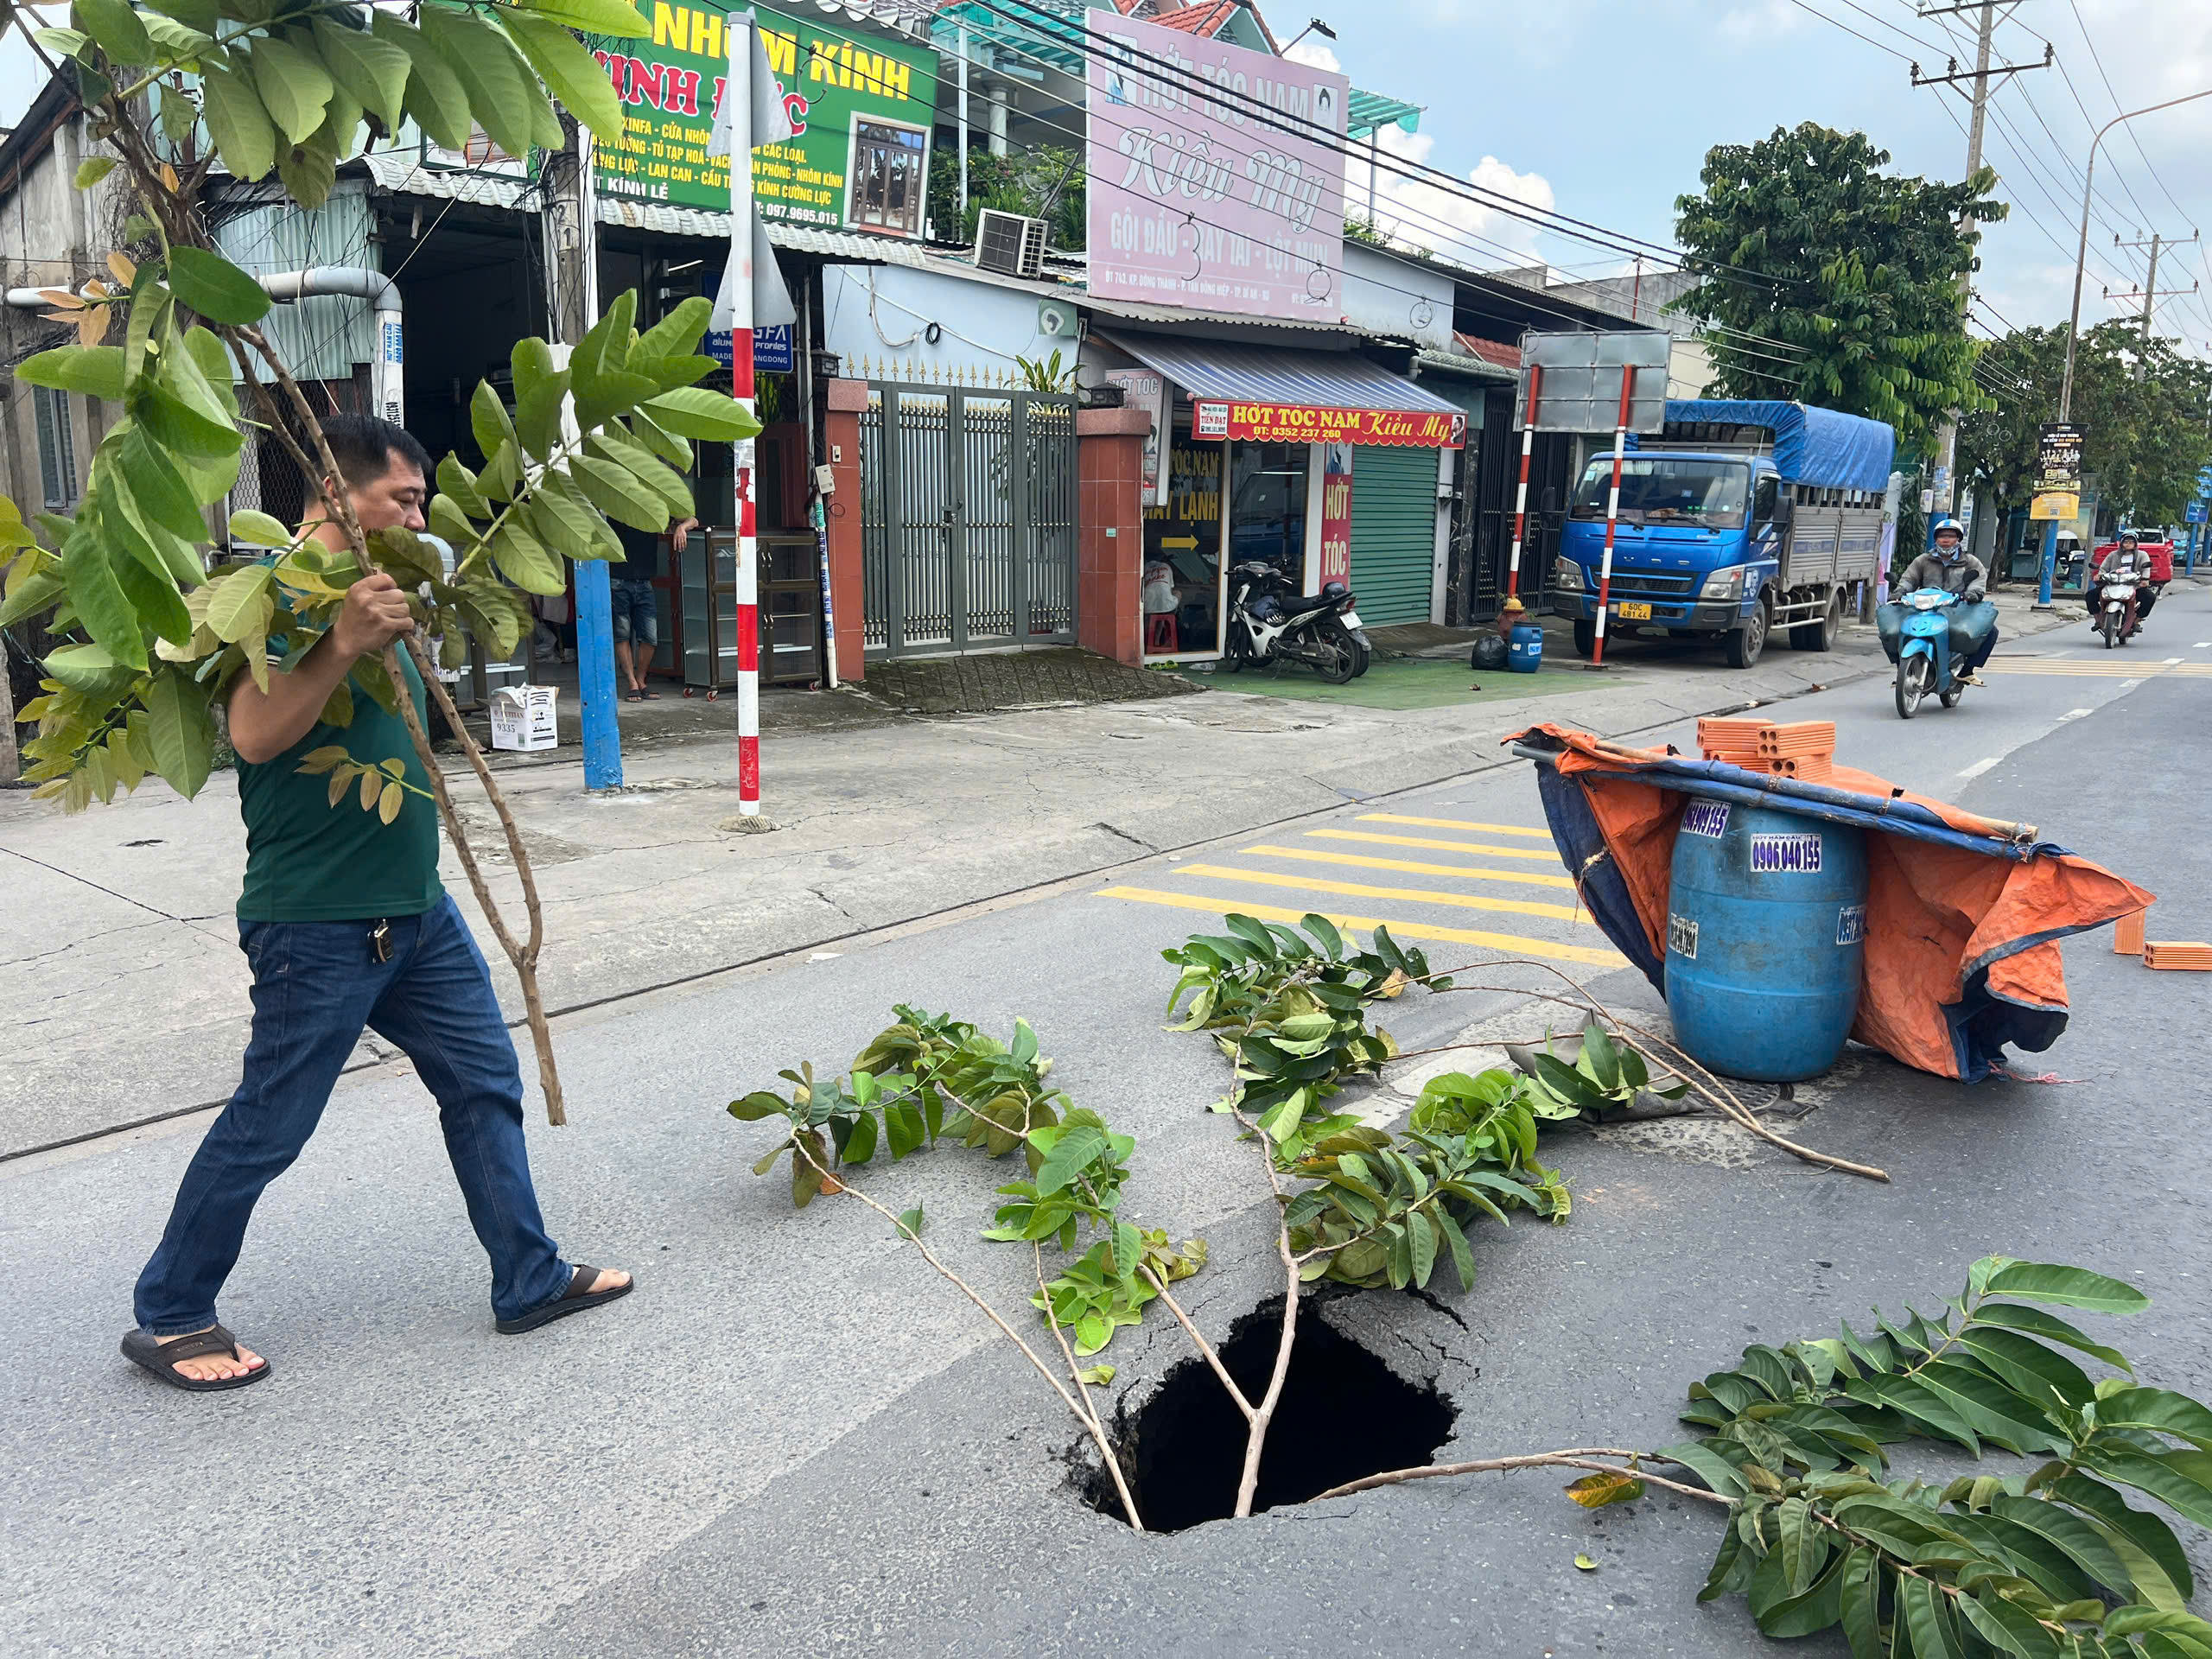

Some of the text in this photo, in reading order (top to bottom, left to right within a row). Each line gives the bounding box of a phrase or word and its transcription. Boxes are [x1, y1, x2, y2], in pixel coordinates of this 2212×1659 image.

[653, 1, 911, 101] NHM KÍNH
[1143, 43, 1309, 137] HỚT TÓC NAM
[662, 121, 682, 141] CỬA
[648, 162, 668, 178] LAN
[671, 166, 691, 182] CAN
[666, 145, 683, 163] TẠP
[763, 162, 791, 180] PHÒNG
[797, 168, 821, 186] NHÔM
[823, 171, 843, 188] KÍNH
[1118, 127, 1325, 234] Kiều My
[608, 176, 646, 196] KÍNH
[651, 182, 668, 200] LẺ
[757, 180, 779, 197] KÍNH
[782, 184, 812, 201] CƯỜNG
[815, 190, 831, 207] LỰC
[766, 203, 838, 226] 097.9695.015
[1136, 375, 1158, 396] TÓC
[1254, 427, 1341, 438] ĐT: 0352 237 260
[1278, 405, 1316, 427] TÓC
[1319, 410, 1361, 429] NAM
[1362, 412, 1413, 436] Kiều
[1417, 415, 1450, 442] My
[1179, 491, 1218, 526] LẠNH
[1325, 477, 1349, 520] HỚT
[1325, 533, 1347, 576] TÓC
[497, 723, 515, 733] 9335
